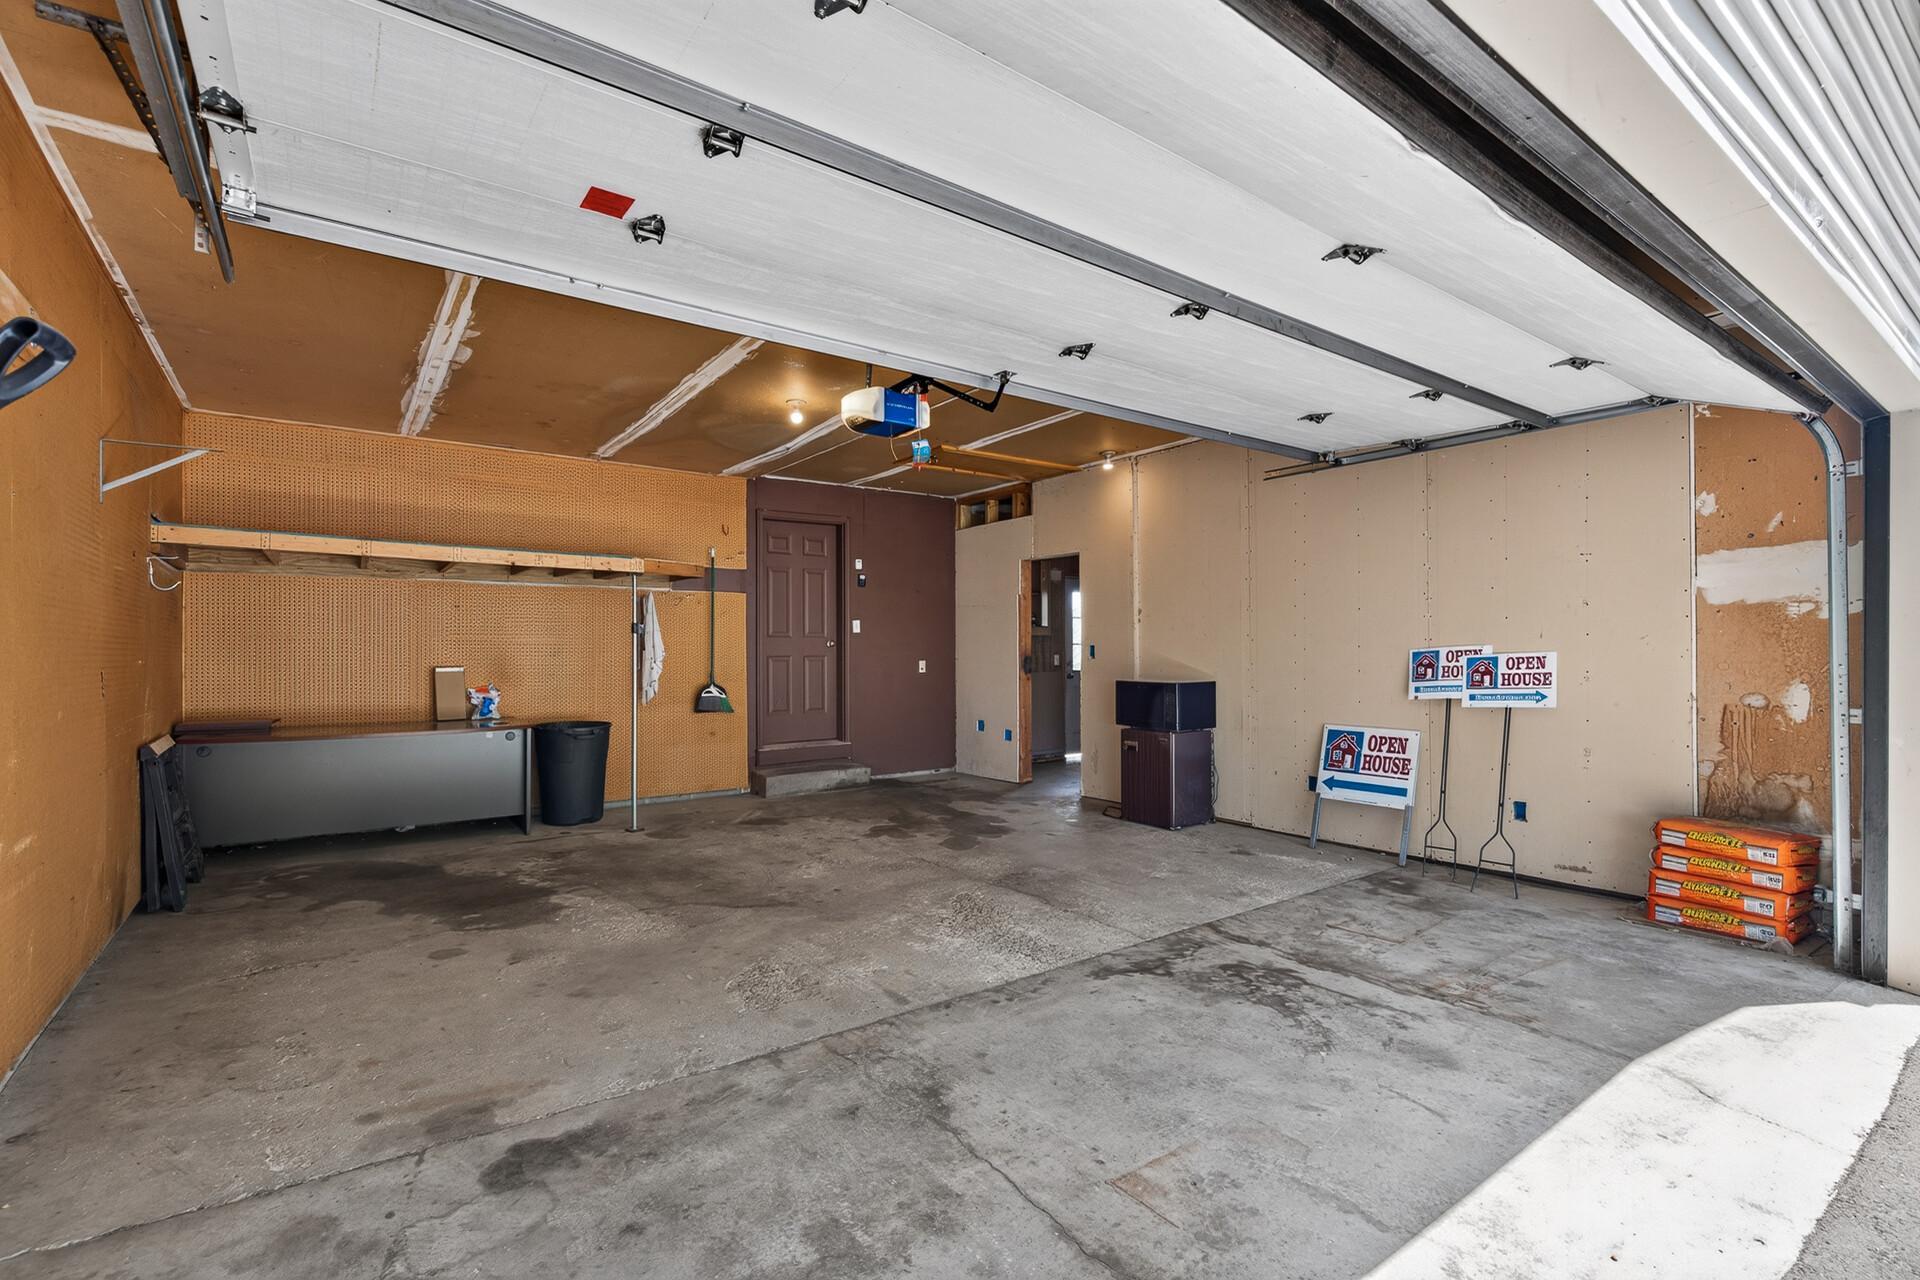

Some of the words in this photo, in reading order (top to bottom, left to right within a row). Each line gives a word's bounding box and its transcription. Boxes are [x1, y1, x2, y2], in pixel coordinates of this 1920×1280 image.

[1506, 655, 1547, 670] OPEN
[1500, 672, 1552, 686] HOUSE
[1367, 735, 1409, 755] OPEN
[1361, 754, 1412, 776] HOUSE
